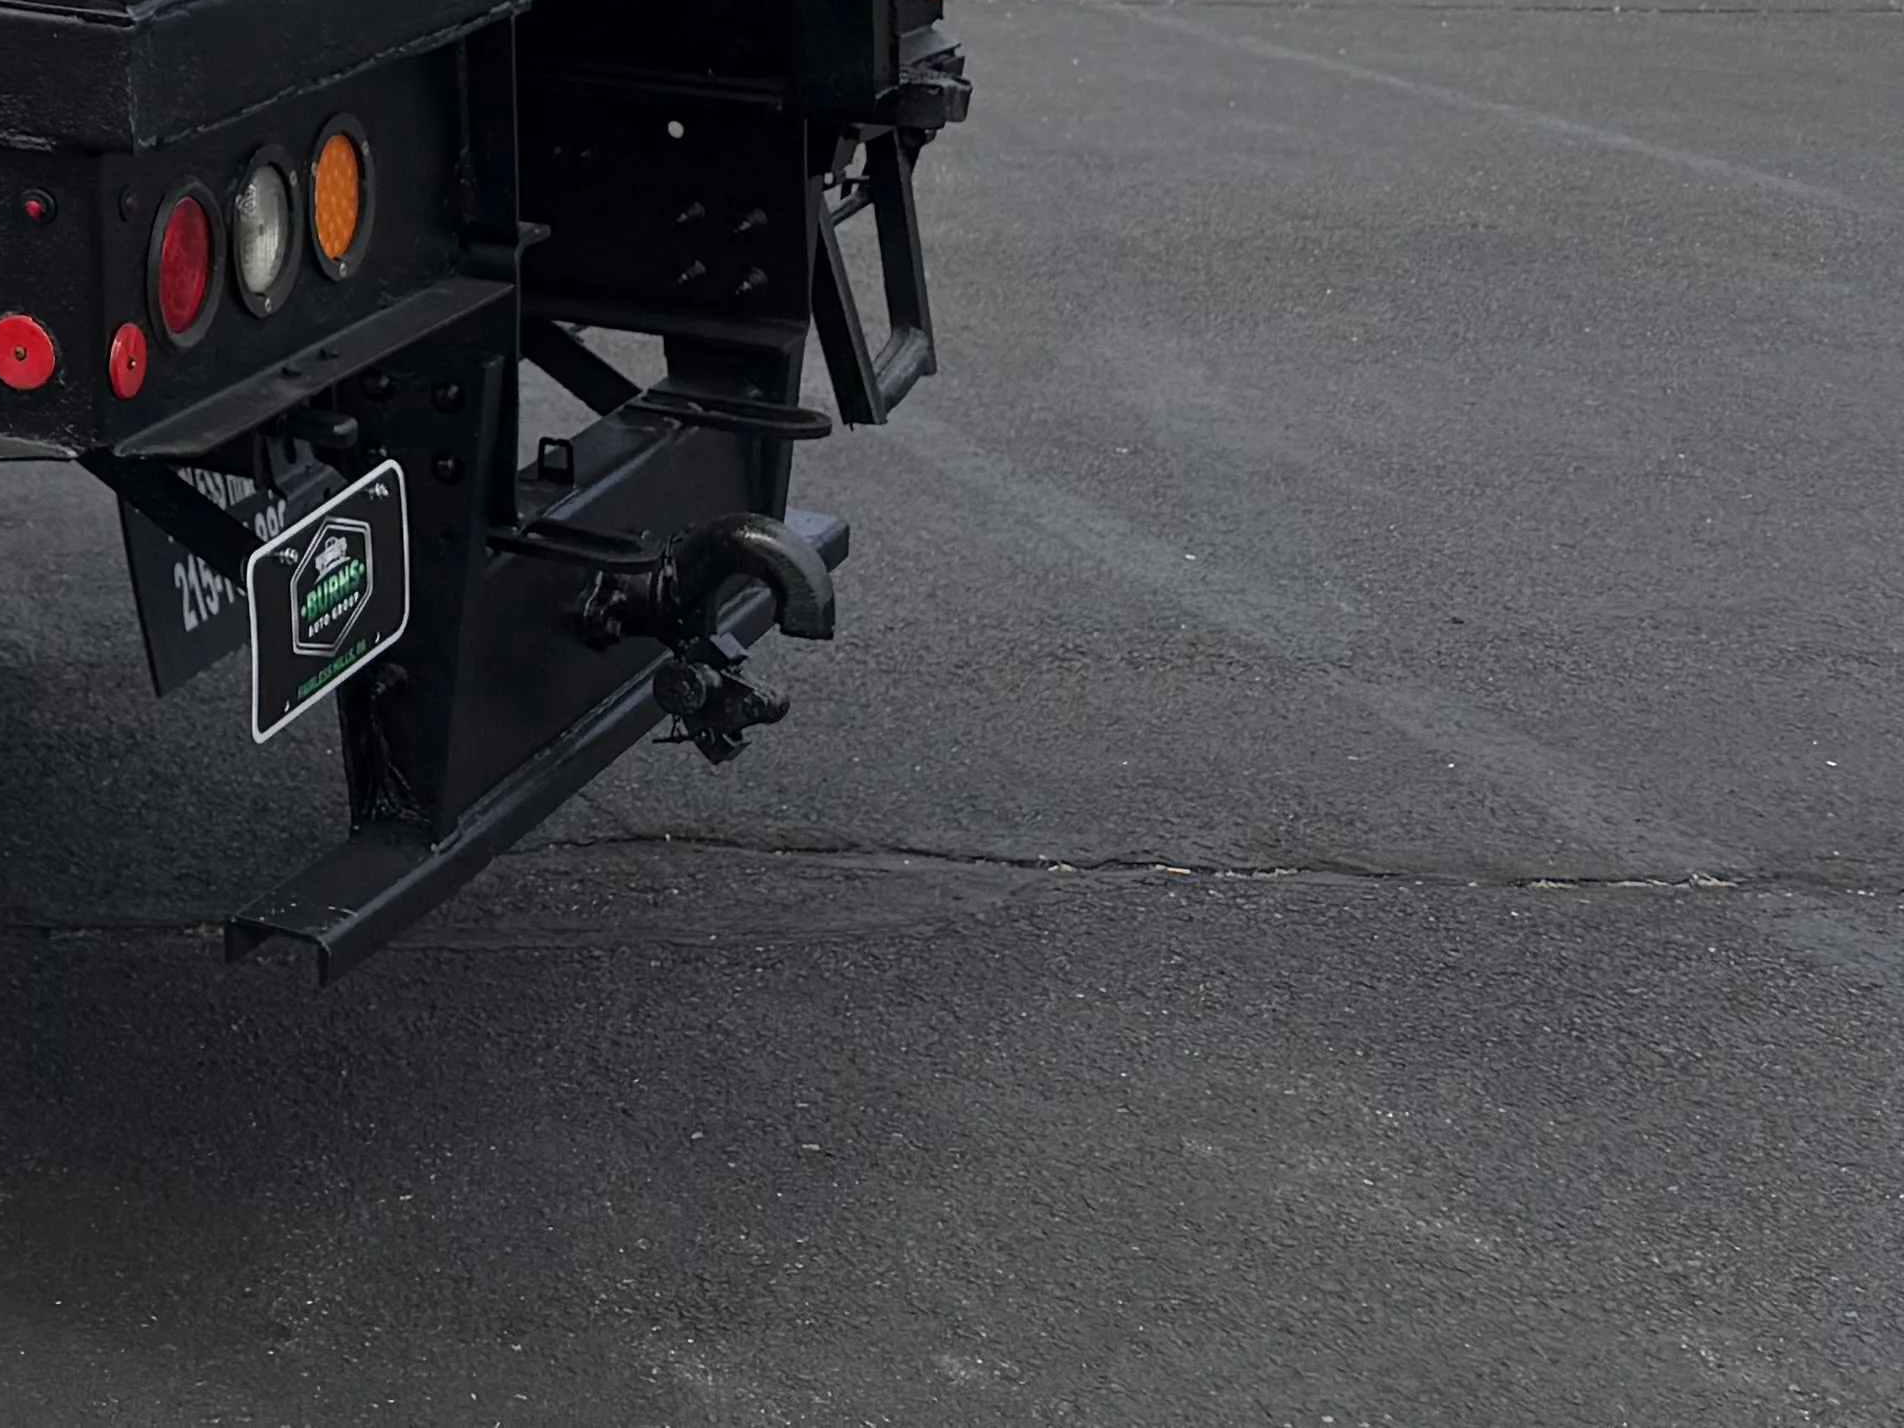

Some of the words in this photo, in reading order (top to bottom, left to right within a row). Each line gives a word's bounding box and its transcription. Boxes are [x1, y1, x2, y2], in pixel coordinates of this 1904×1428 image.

[307, 558, 361, 624] BURNS
[308, 612, 332, 639] AUTO
[331, 590, 361, 621] GROUP
